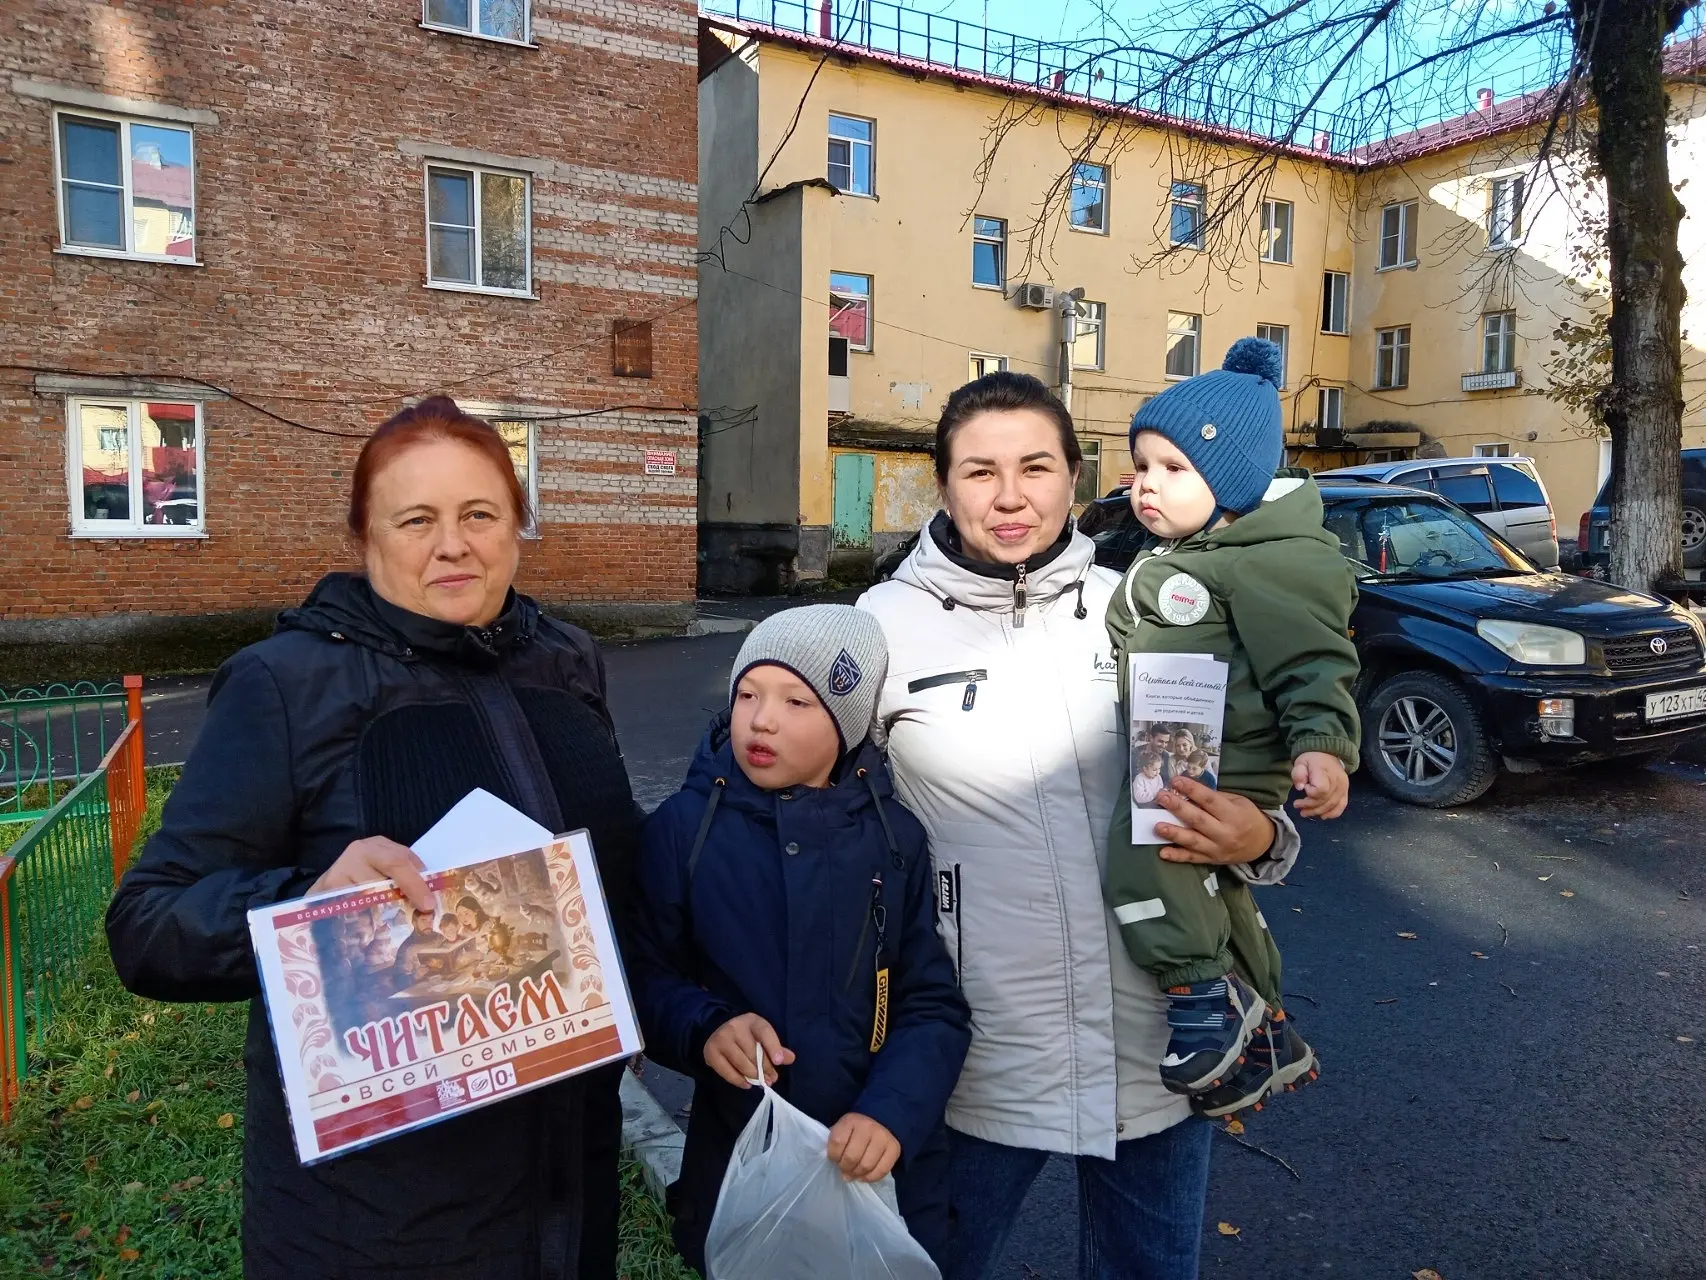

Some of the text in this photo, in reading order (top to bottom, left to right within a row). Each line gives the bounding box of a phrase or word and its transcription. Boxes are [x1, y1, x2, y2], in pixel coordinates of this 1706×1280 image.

[1139, 672, 1177, 685] Читаем
[1179, 676, 1194, 687] всей
[297, 892, 393, 919] всекузбасская
[360, 1063, 438, 1100] всей
[462, 1020, 575, 1068] семьей
